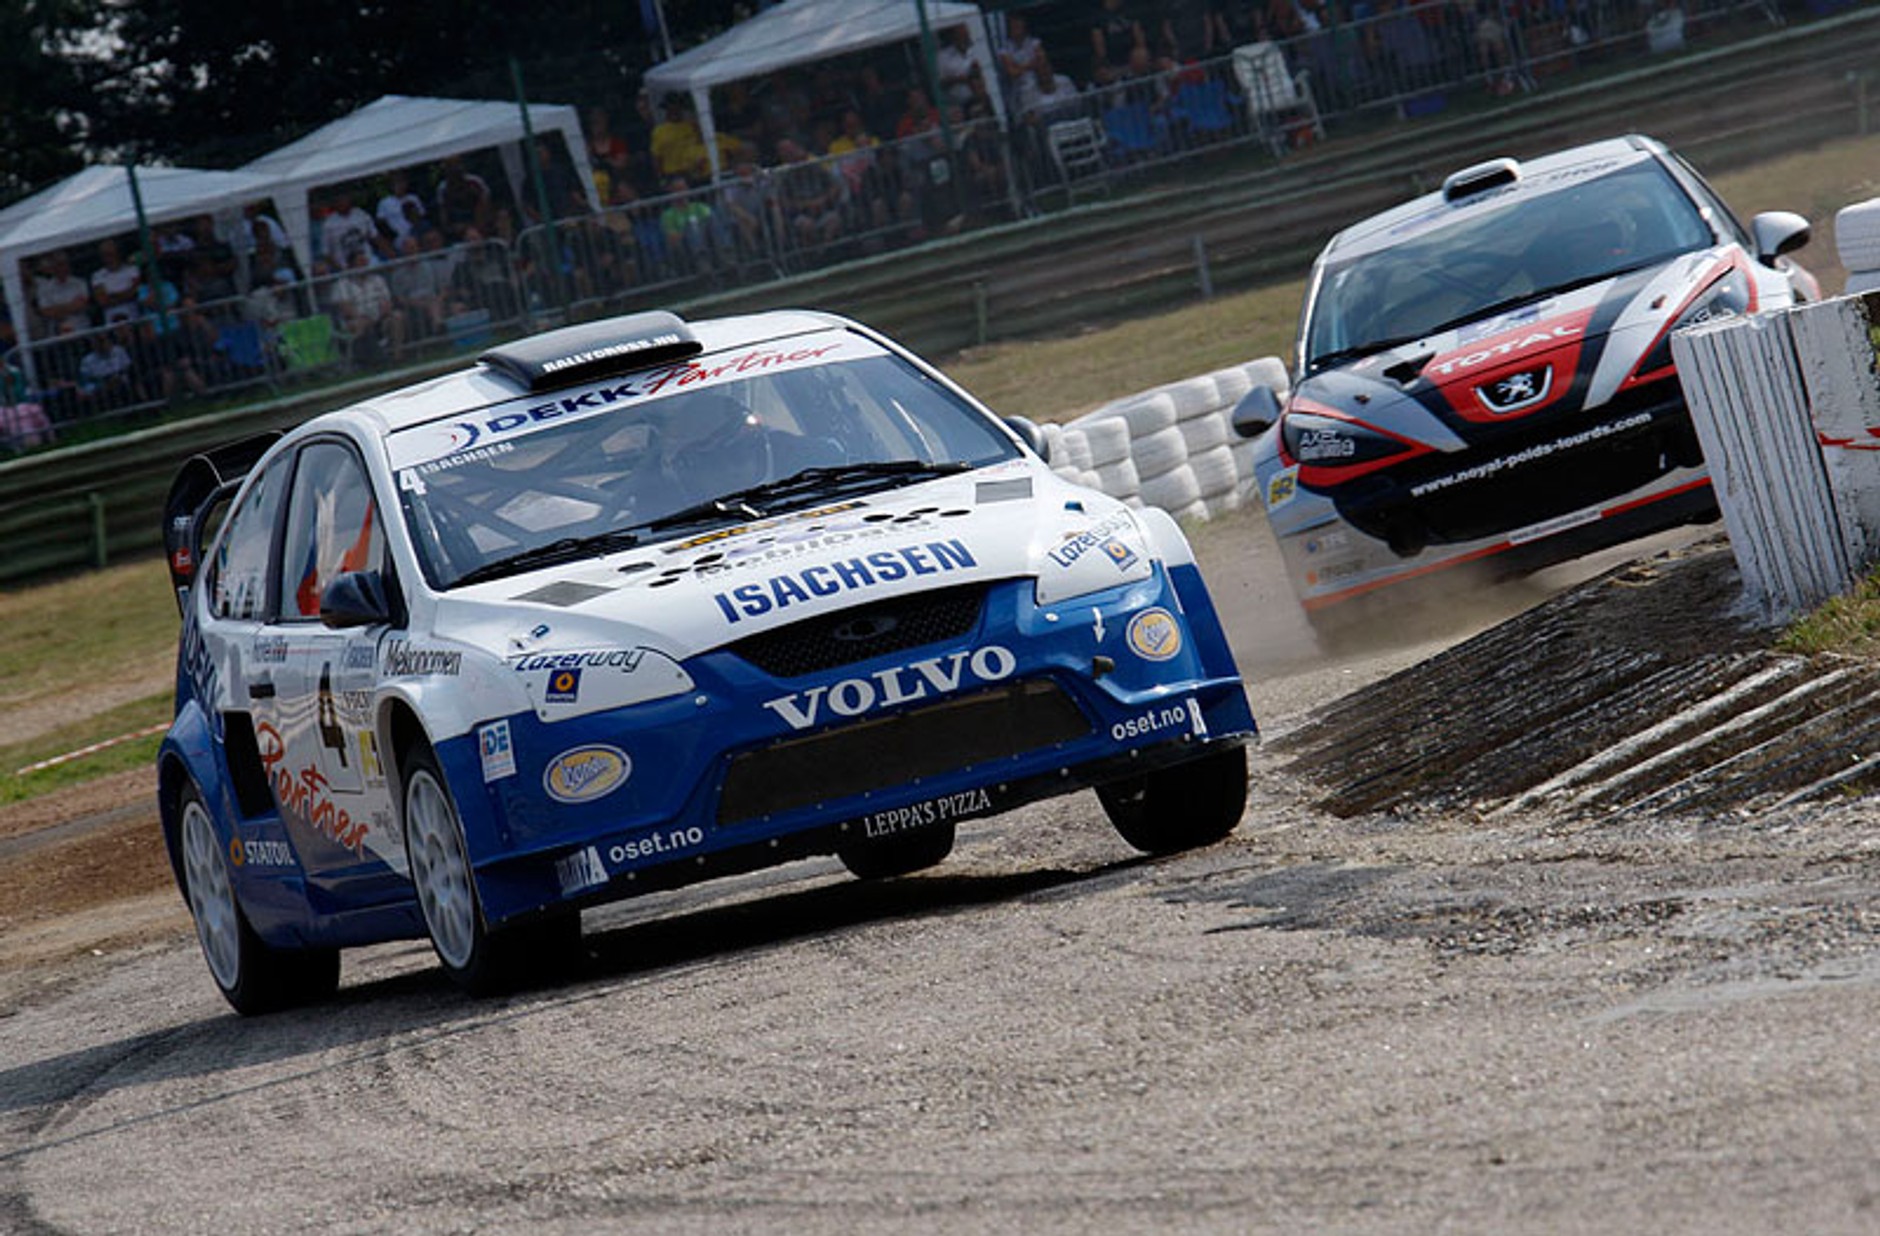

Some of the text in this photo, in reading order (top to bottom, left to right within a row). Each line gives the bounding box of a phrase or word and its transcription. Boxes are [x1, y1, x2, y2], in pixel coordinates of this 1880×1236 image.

[1429, 325, 1582, 375] TOTAL
[399, 467, 427, 496] 4
[419, 441, 515, 474] ISACHSEN
[714, 539, 976, 624] ISACHSEN
[762, 646, 1016, 730] VOLVO
[318, 660, 348, 768] 4
[1111, 705, 1186, 740] oset.no
[864, 788, 992, 838] LEPPA'S PIZZA
[608, 826, 704, 863] oset.no
